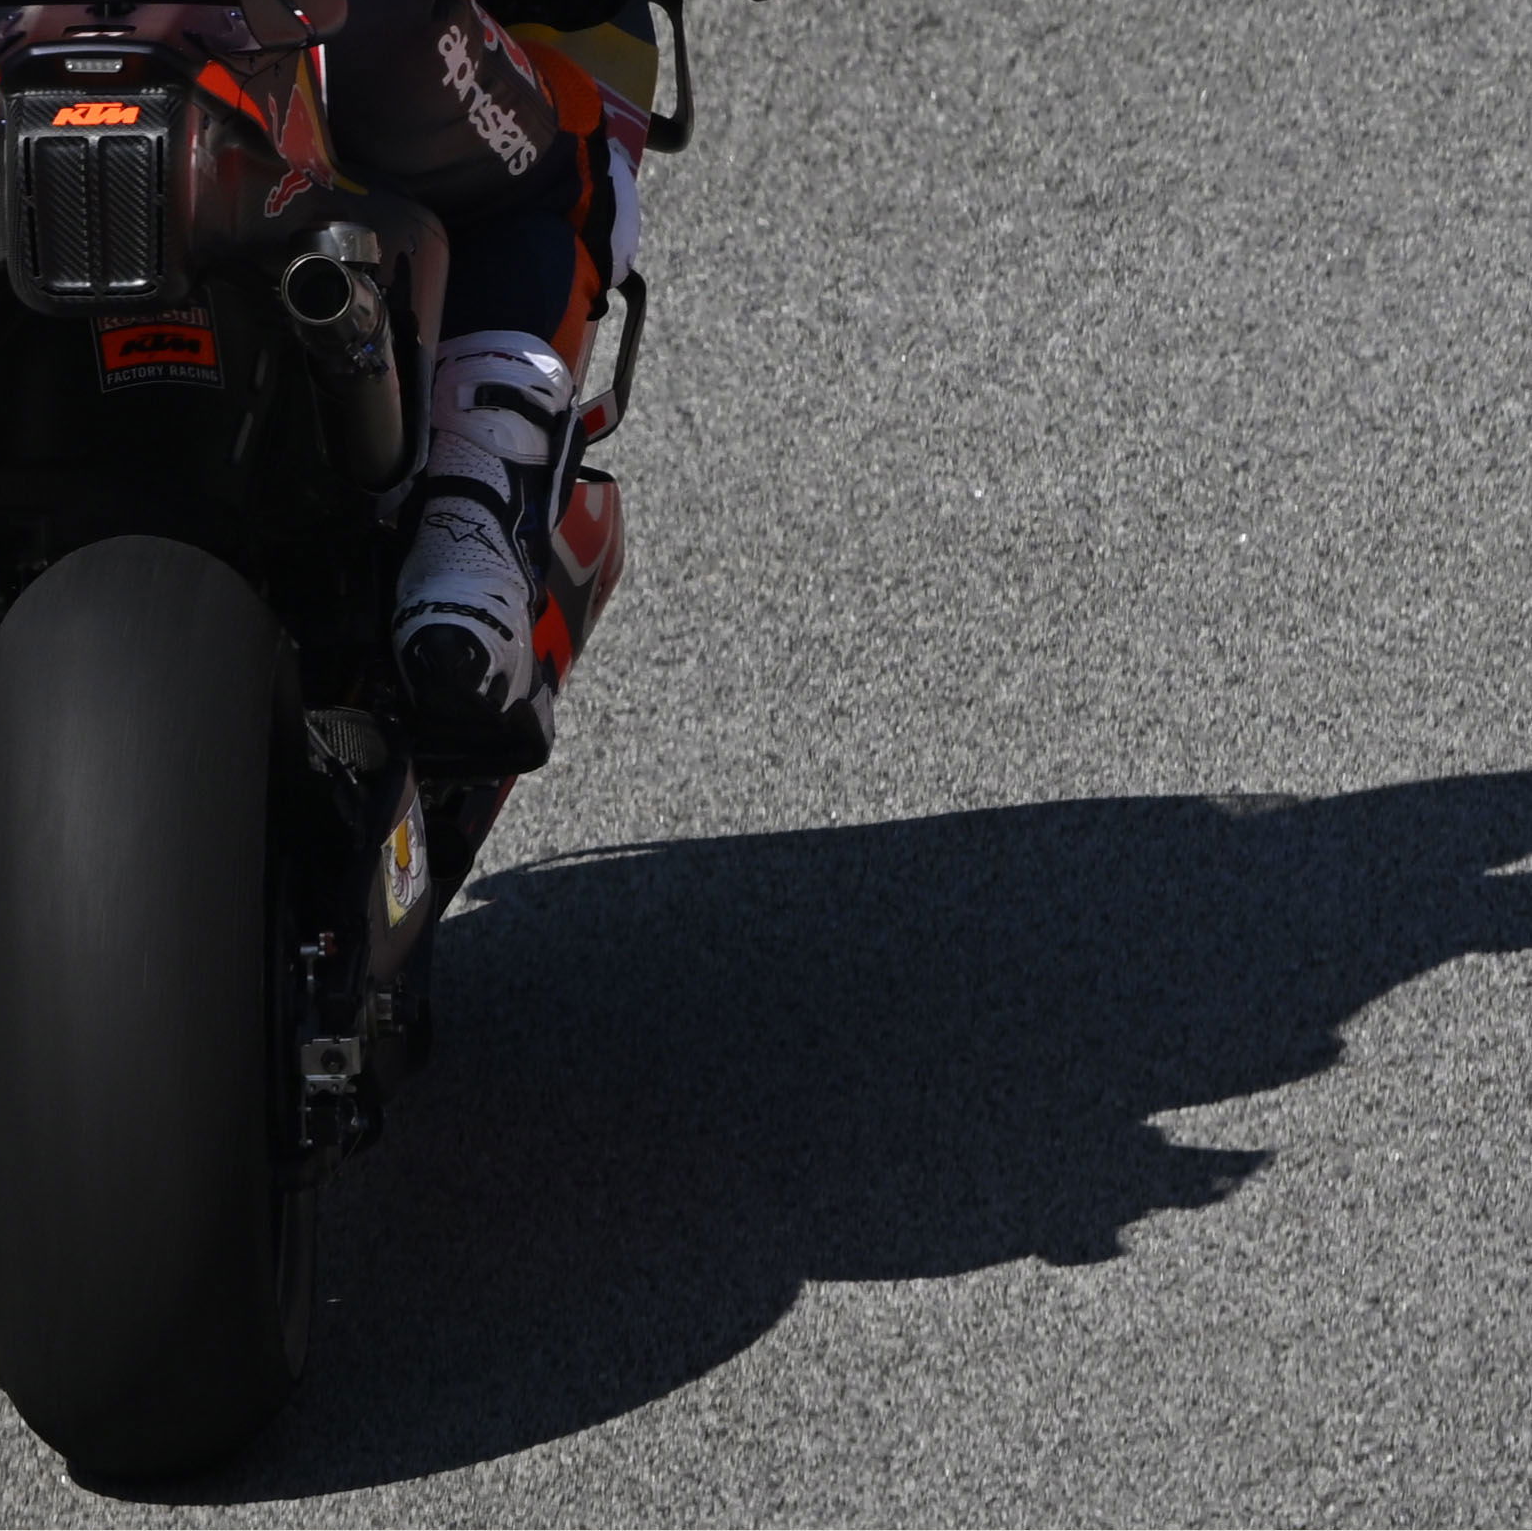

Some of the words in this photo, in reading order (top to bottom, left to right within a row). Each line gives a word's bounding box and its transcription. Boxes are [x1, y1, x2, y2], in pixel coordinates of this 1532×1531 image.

[438, 25, 537, 175] alpinestars
[52, 102, 140, 125] KTM
[119, 331, 202, 357] KTM
[106, 365, 164, 385] FACTORY
[169, 365, 219, 382] RACING
